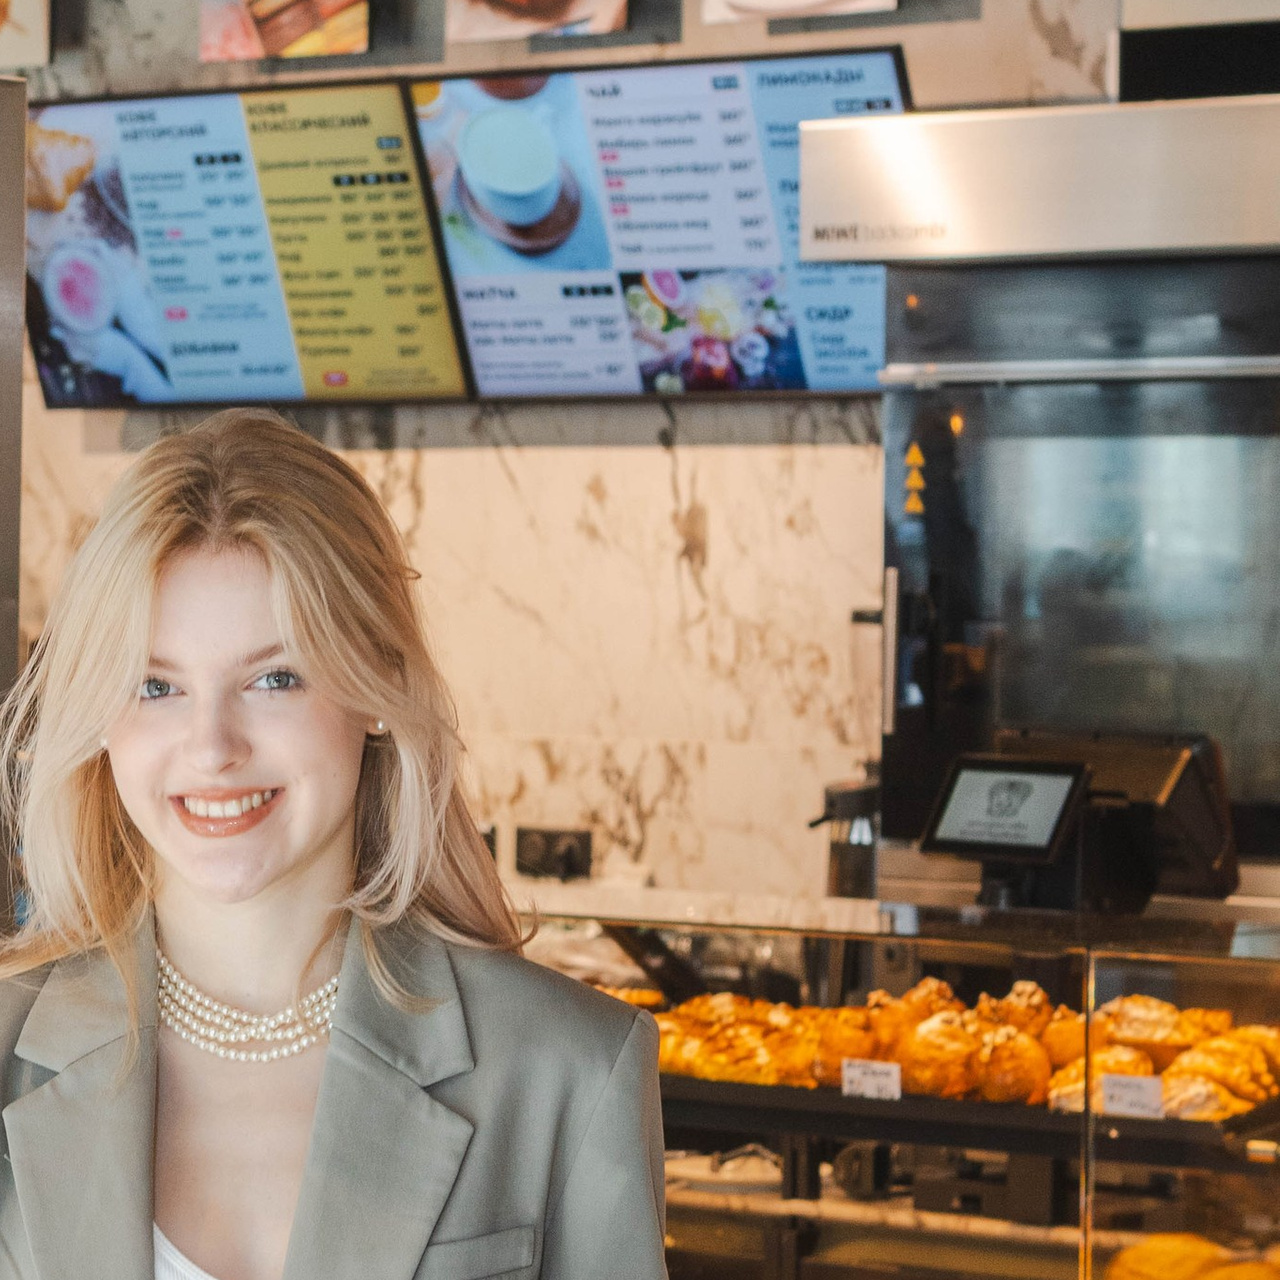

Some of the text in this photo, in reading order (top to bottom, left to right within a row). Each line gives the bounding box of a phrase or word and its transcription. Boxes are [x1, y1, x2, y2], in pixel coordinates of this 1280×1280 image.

[757, 68, 865, 88] ЛИМОНАДЫ
[587, 83, 621, 98] ЧАЙ
[246, 103, 287, 117] КОФЕ
[250, 113, 370, 133] КЛАССИЧЕСКИЙ
